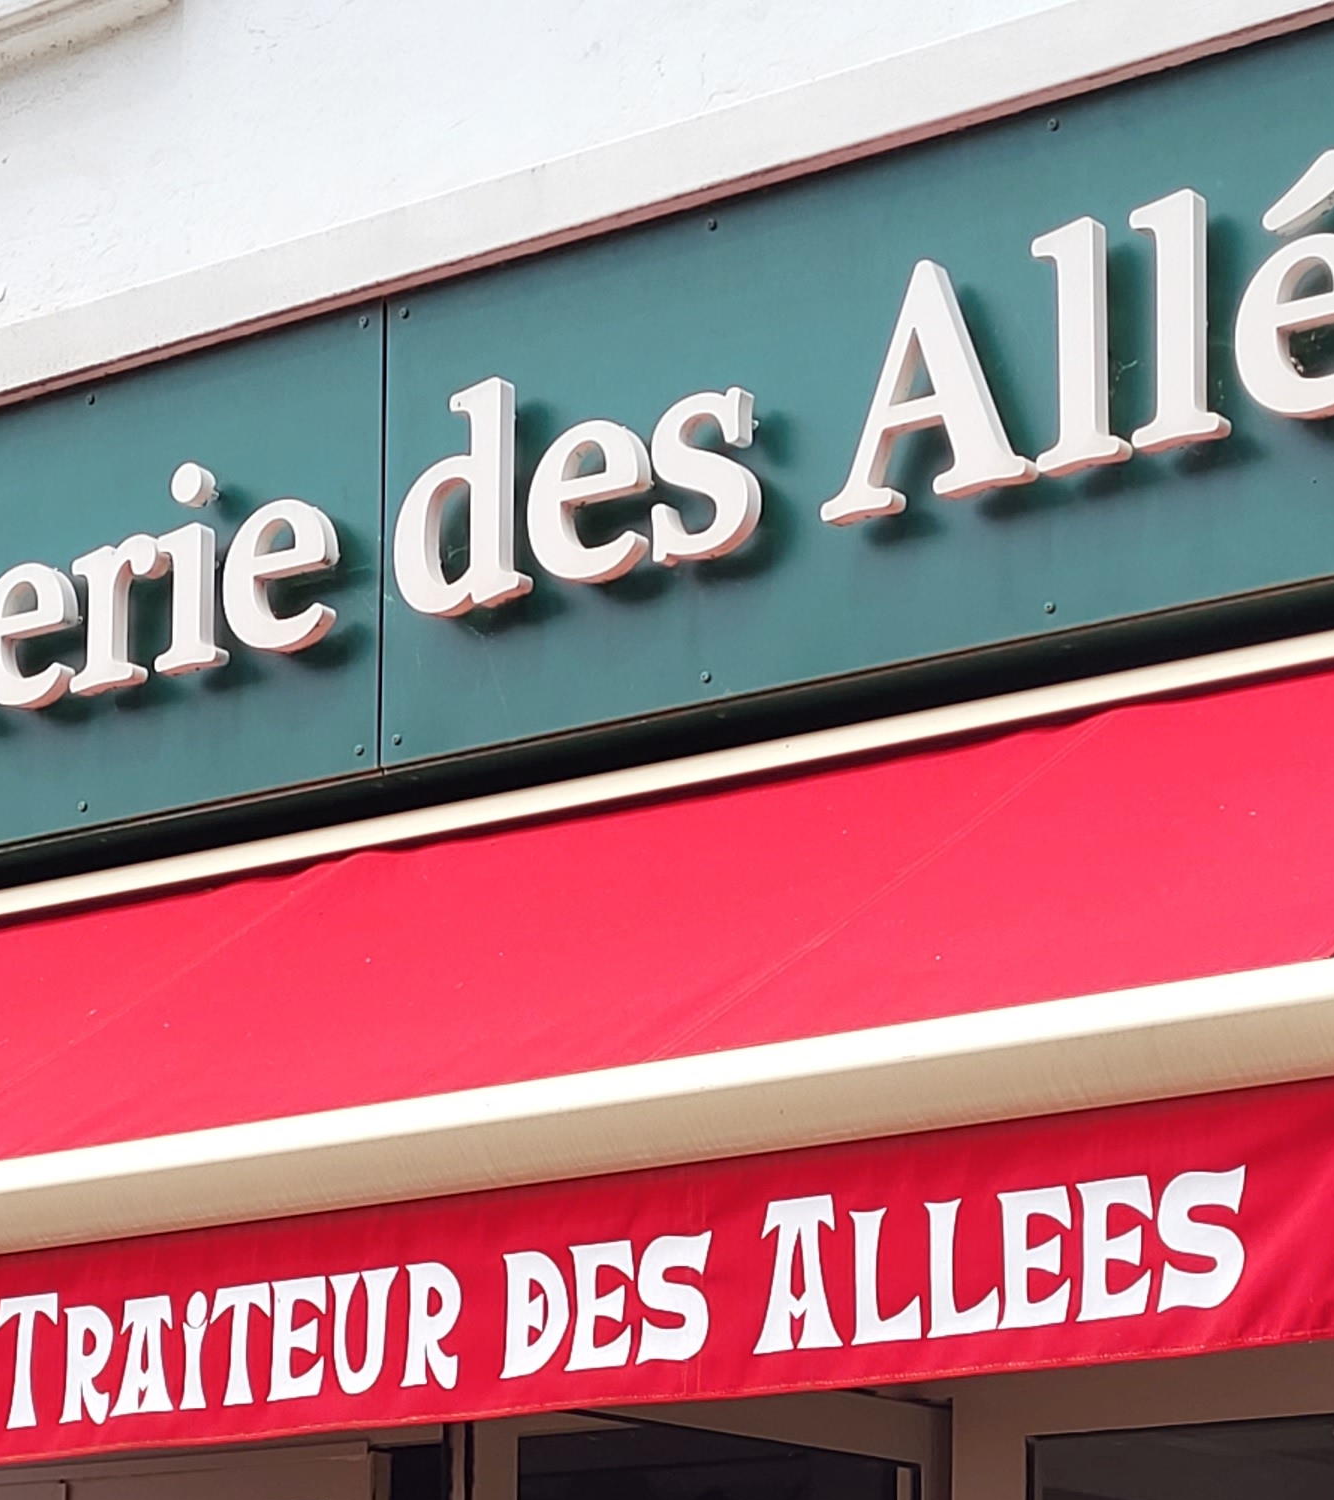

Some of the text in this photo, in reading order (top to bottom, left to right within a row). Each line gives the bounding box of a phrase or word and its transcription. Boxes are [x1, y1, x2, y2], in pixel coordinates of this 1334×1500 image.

[393, 377, 762, 618] des
[500, 1231, 714, 1379] DES
[752, 1164, 1247, 1354] ALLEES
